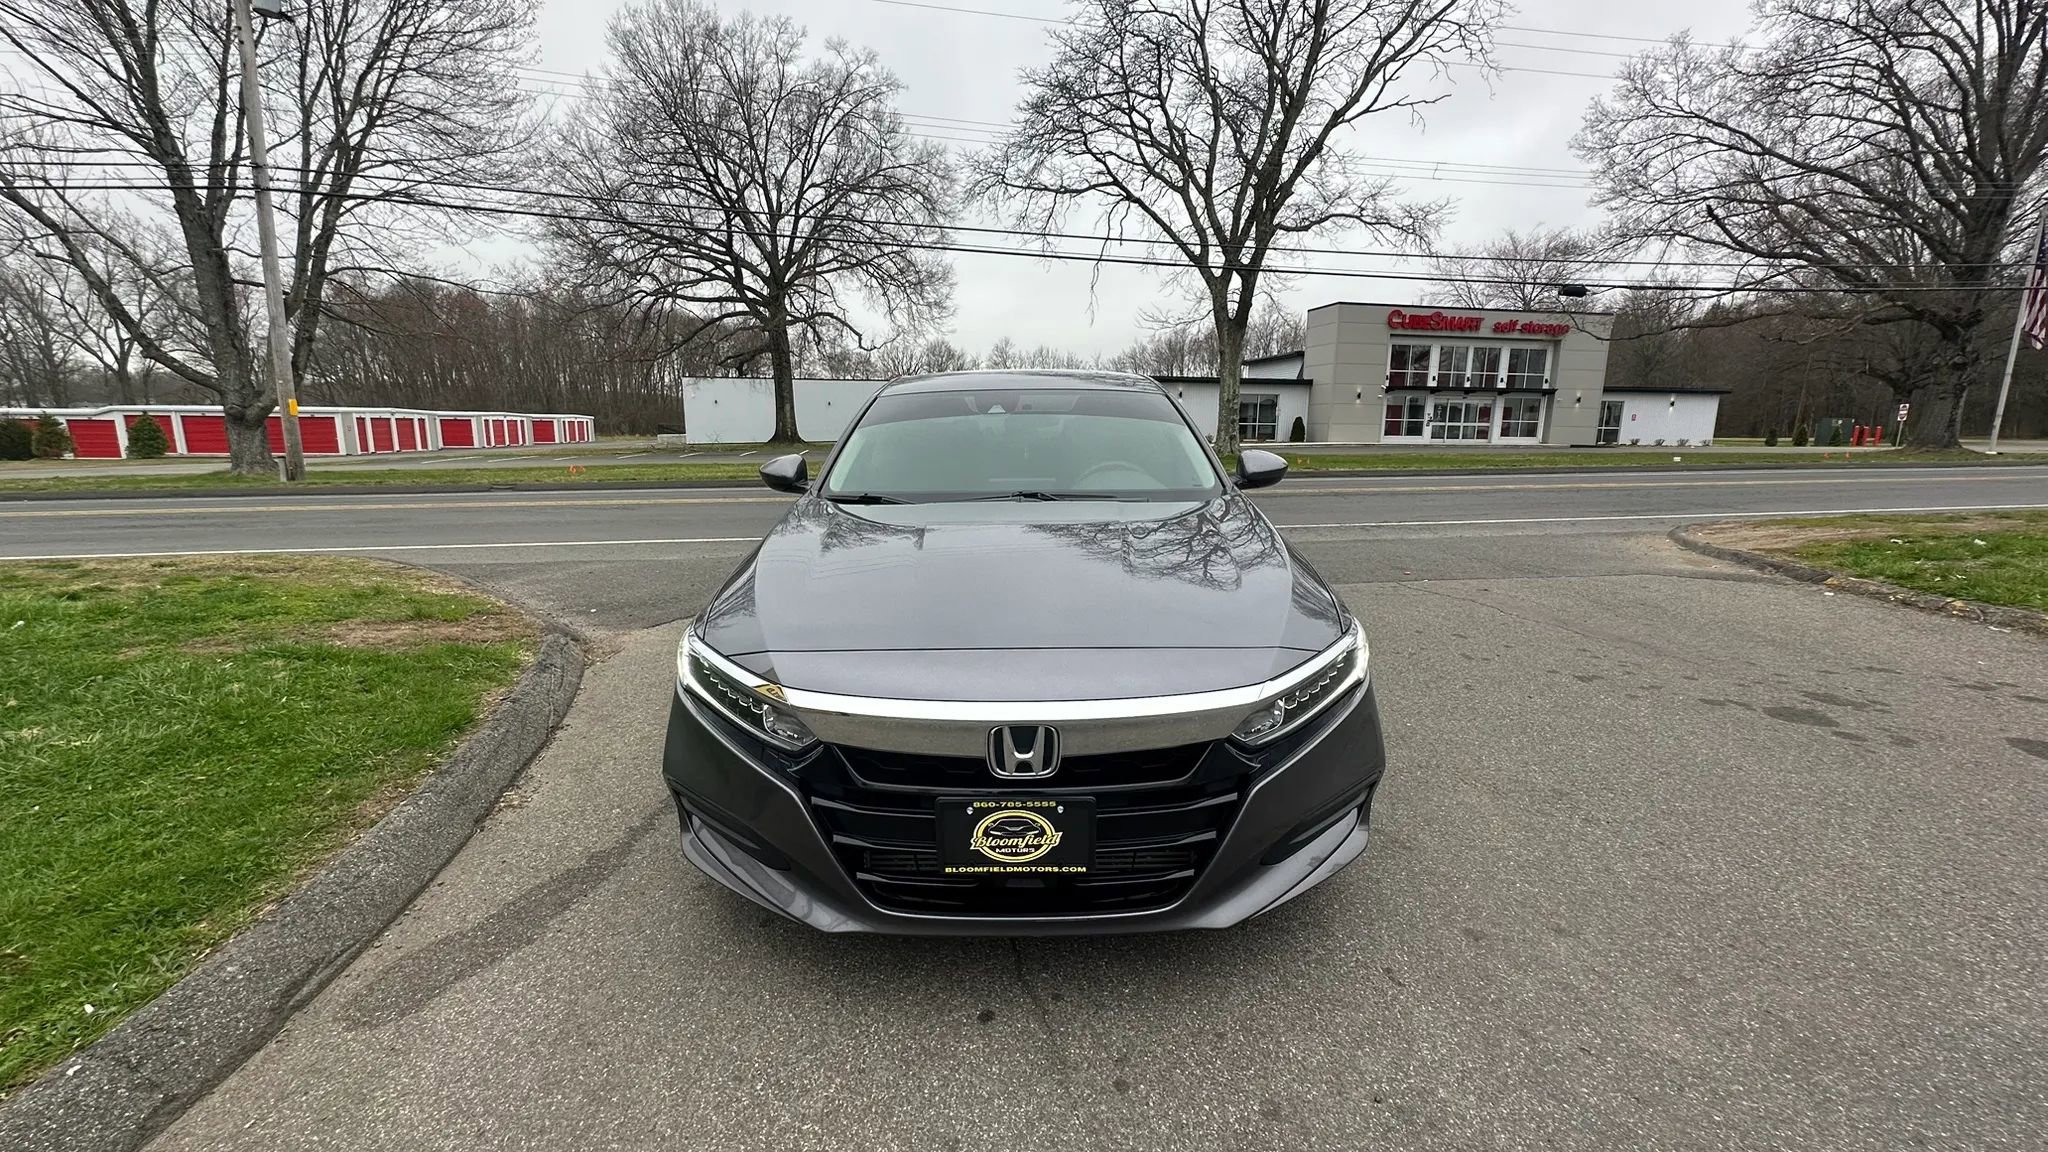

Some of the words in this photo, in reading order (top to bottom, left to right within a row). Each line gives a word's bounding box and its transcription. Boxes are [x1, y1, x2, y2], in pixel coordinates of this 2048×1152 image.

[1493, 319, 1520, 334] self
[1521, 321, 1571, 337] storage
[974, 834, 1058, 849] Bloomfield
